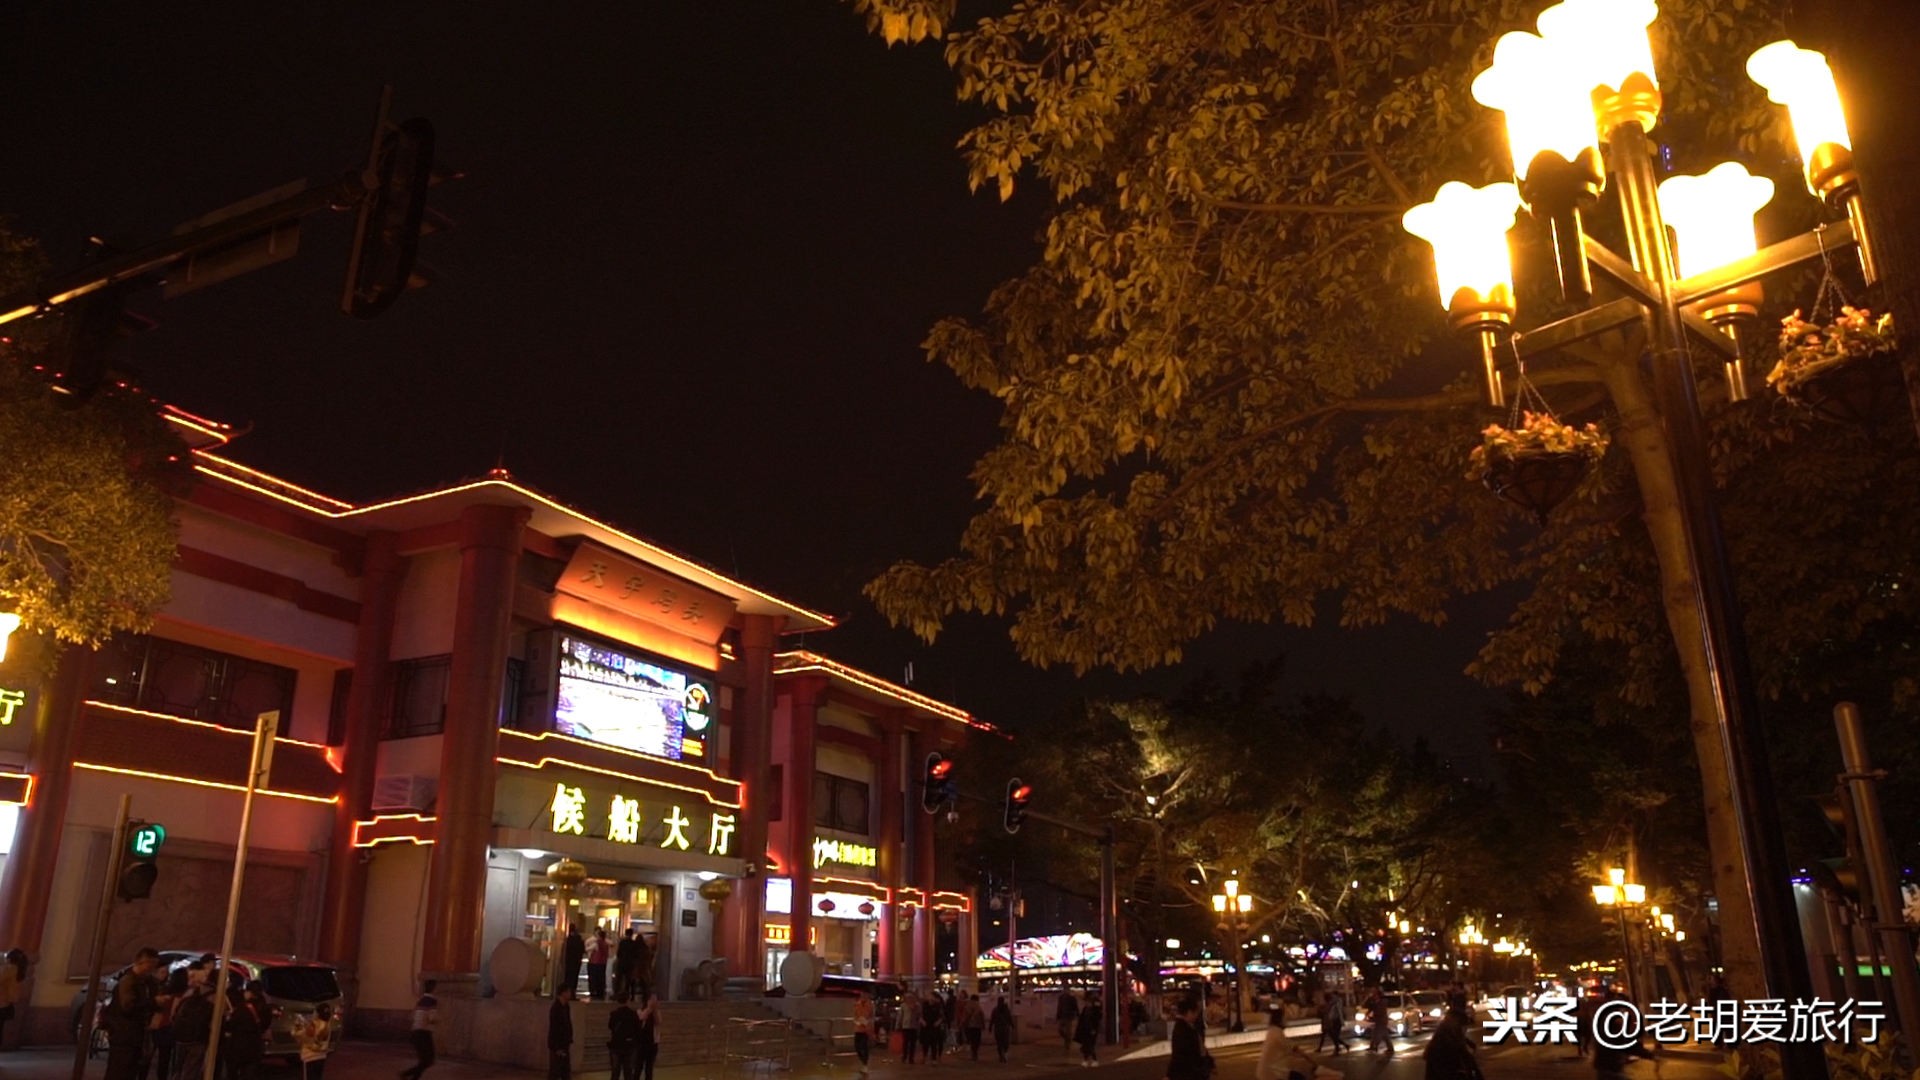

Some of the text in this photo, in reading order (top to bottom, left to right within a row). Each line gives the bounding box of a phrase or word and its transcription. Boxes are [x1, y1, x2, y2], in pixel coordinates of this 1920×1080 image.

[136, 830, 156, 853] 12
[551, 782, 736, 856] 候船大厅
